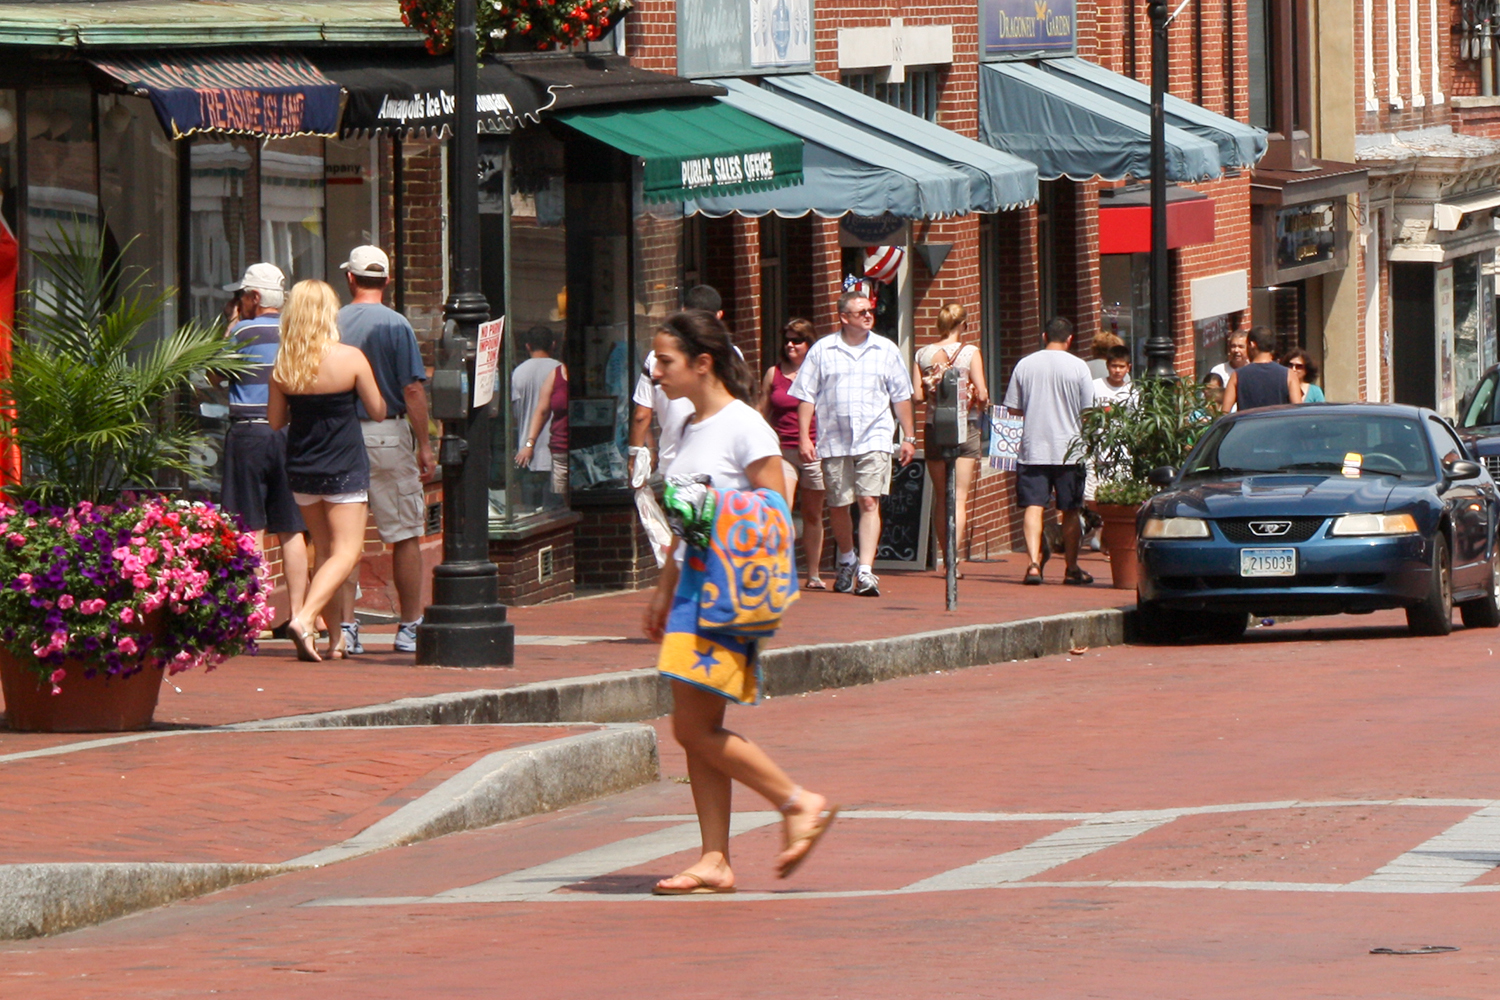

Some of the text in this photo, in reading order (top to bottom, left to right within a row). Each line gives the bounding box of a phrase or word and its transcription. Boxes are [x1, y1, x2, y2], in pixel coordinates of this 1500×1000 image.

[999, 9, 1071, 38] DRAGONFLY GARDEN
[194, 87, 262, 131] TREASURE
[377, 94, 425, 124] Annapolis
[426, 93, 441, 117] Ice
[681, 151, 774, 189] PUBLIC SALES OFFICE
[481, 325, 488, 338] NO
[1250, 556, 1286, 570] 21503
